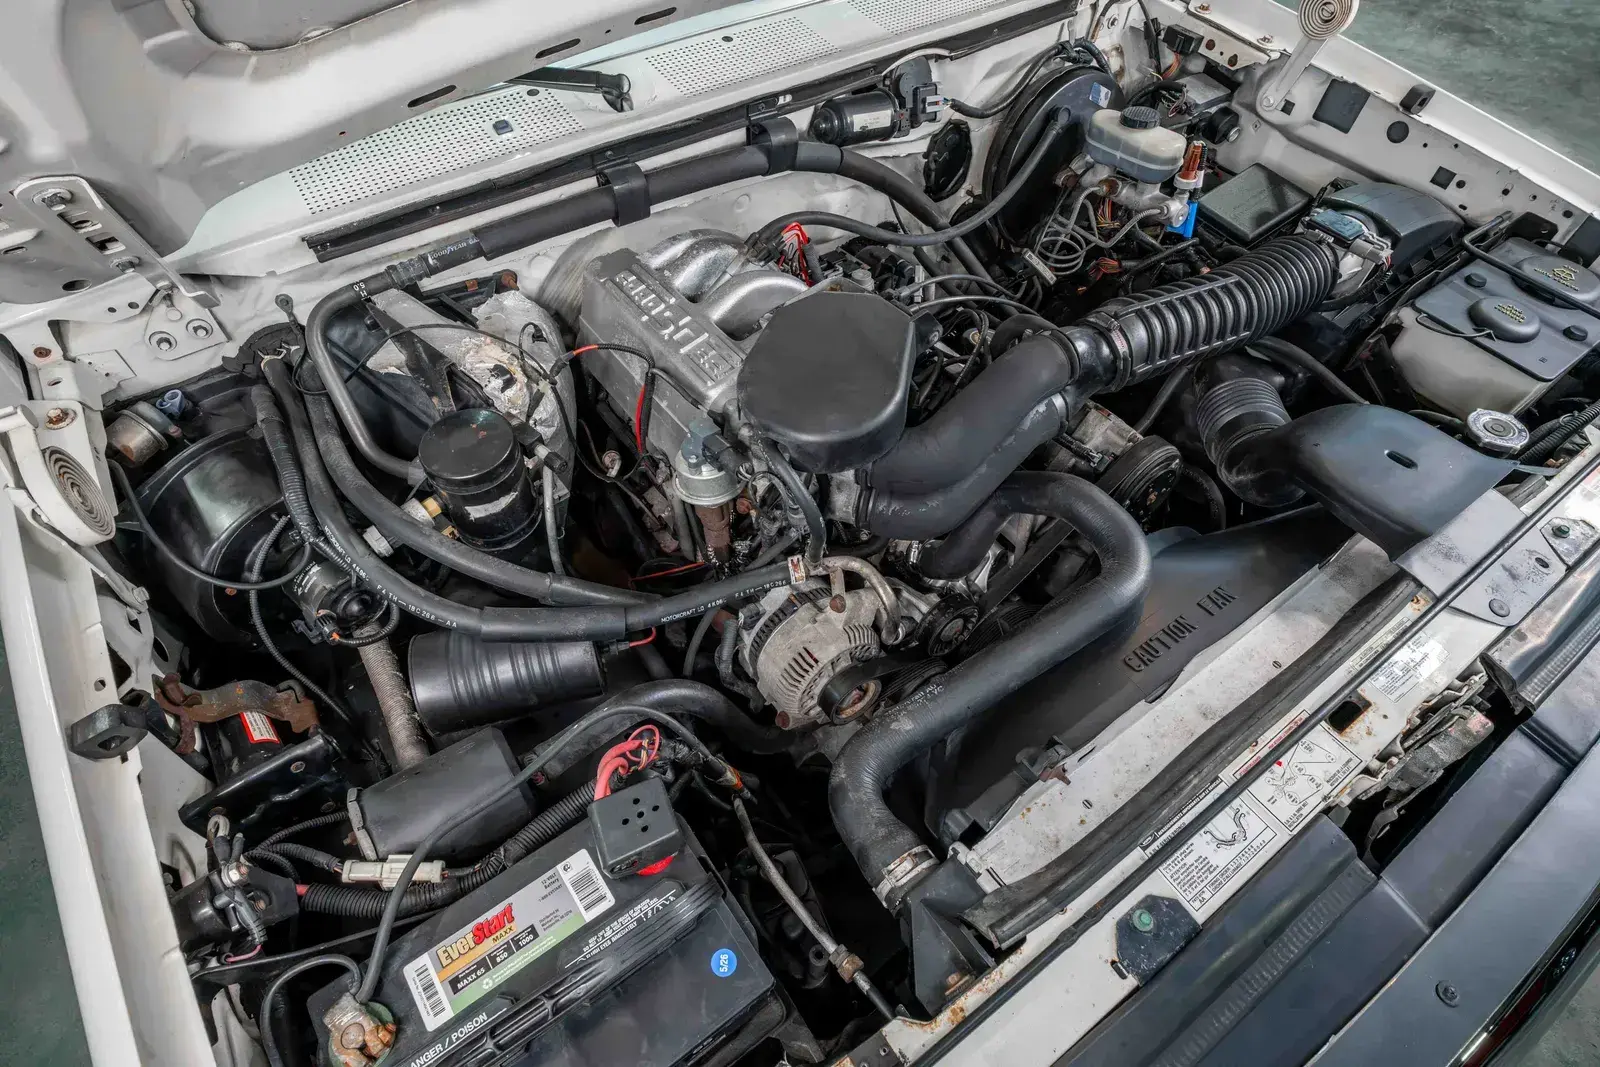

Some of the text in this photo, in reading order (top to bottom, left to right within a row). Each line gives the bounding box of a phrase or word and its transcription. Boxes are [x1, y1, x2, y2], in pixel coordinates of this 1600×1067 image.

[660, 607, 696, 623] MOTORCRAFT
[1123, 585, 1239, 673] CAUTION FAN
[437, 903, 515, 967] EverStart
[490, 925, 515, 944] MAXX
[517, 933, 534, 947] 1000
[494, 950, 508, 963] 850
[719, 953, 728, 972] 5/26
[456, 966, 486, 989] MAXX 65
[450, 1012, 488, 1042] POISON
